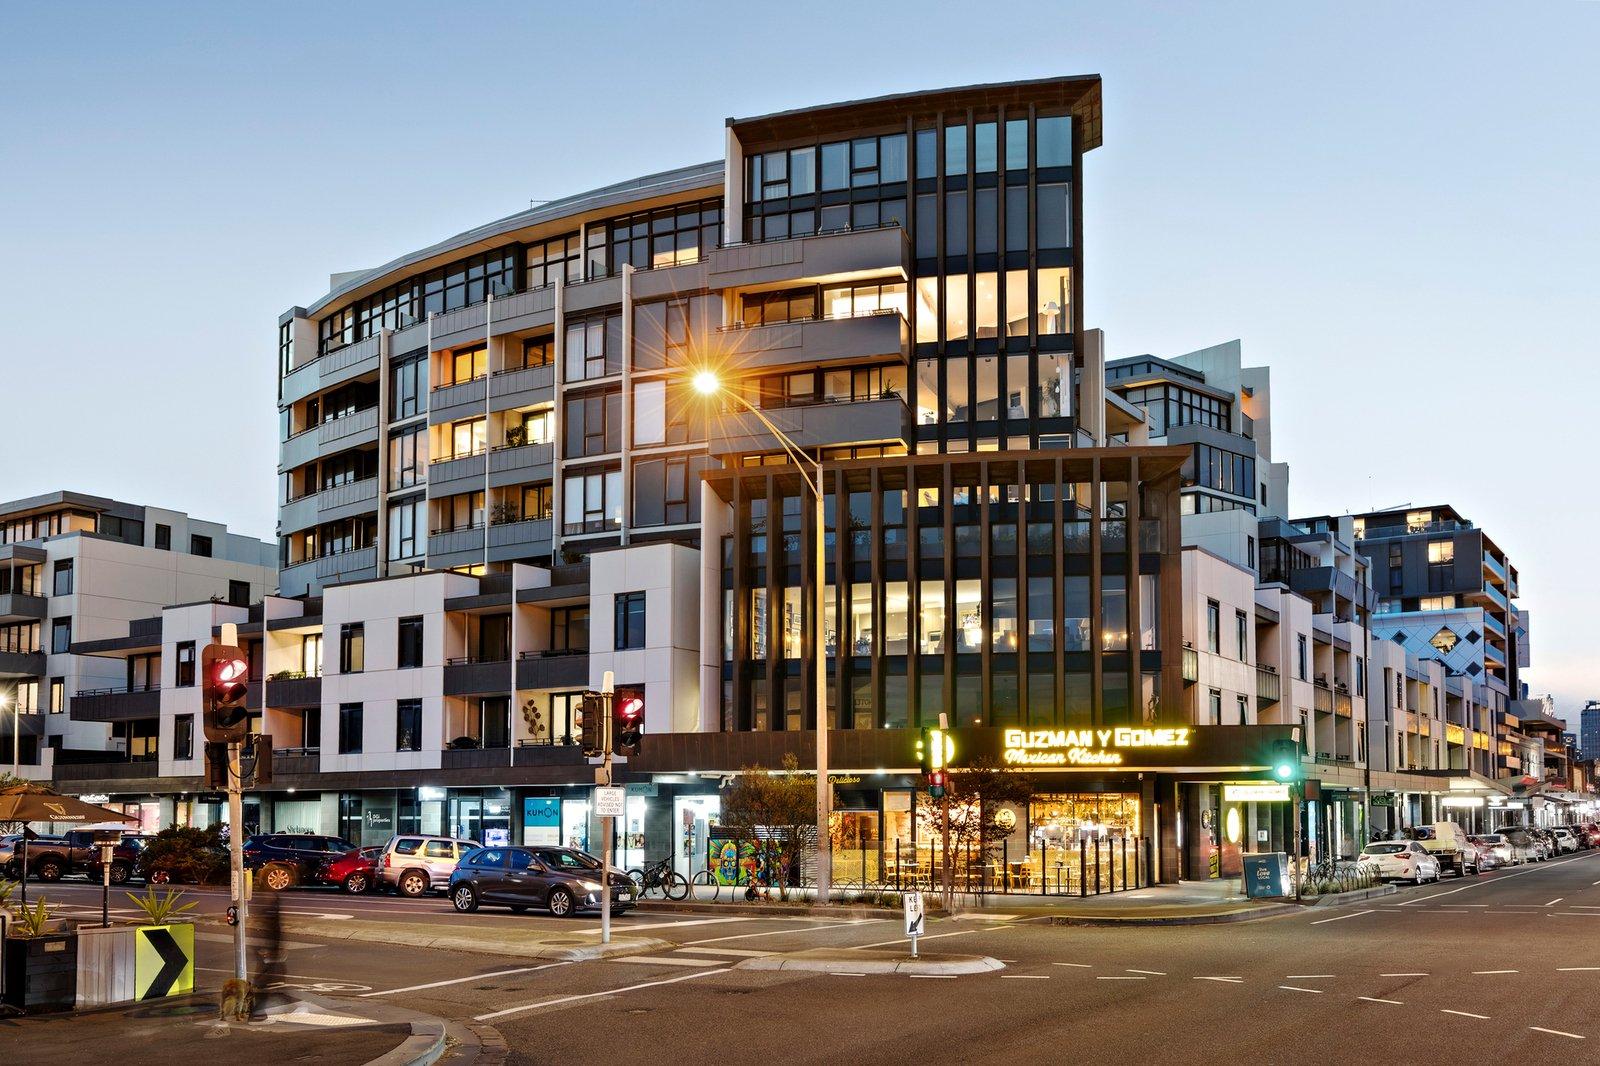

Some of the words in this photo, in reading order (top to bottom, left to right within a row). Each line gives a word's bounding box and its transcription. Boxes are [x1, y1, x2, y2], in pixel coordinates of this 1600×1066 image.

[1004, 729, 1093, 748] GUZMAN
[1097, 730, 1112, 747] Y
[1114, 727, 1190, 747] GOMEZ
[1004, 749, 1067, 764] Mexican
[1068, 747, 1122, 764] Kitchen
[828, 775, 861, 784] Delicioso
[631, 785, 652, 793] KUMON
[526, 807, 559, 818] KUMON
